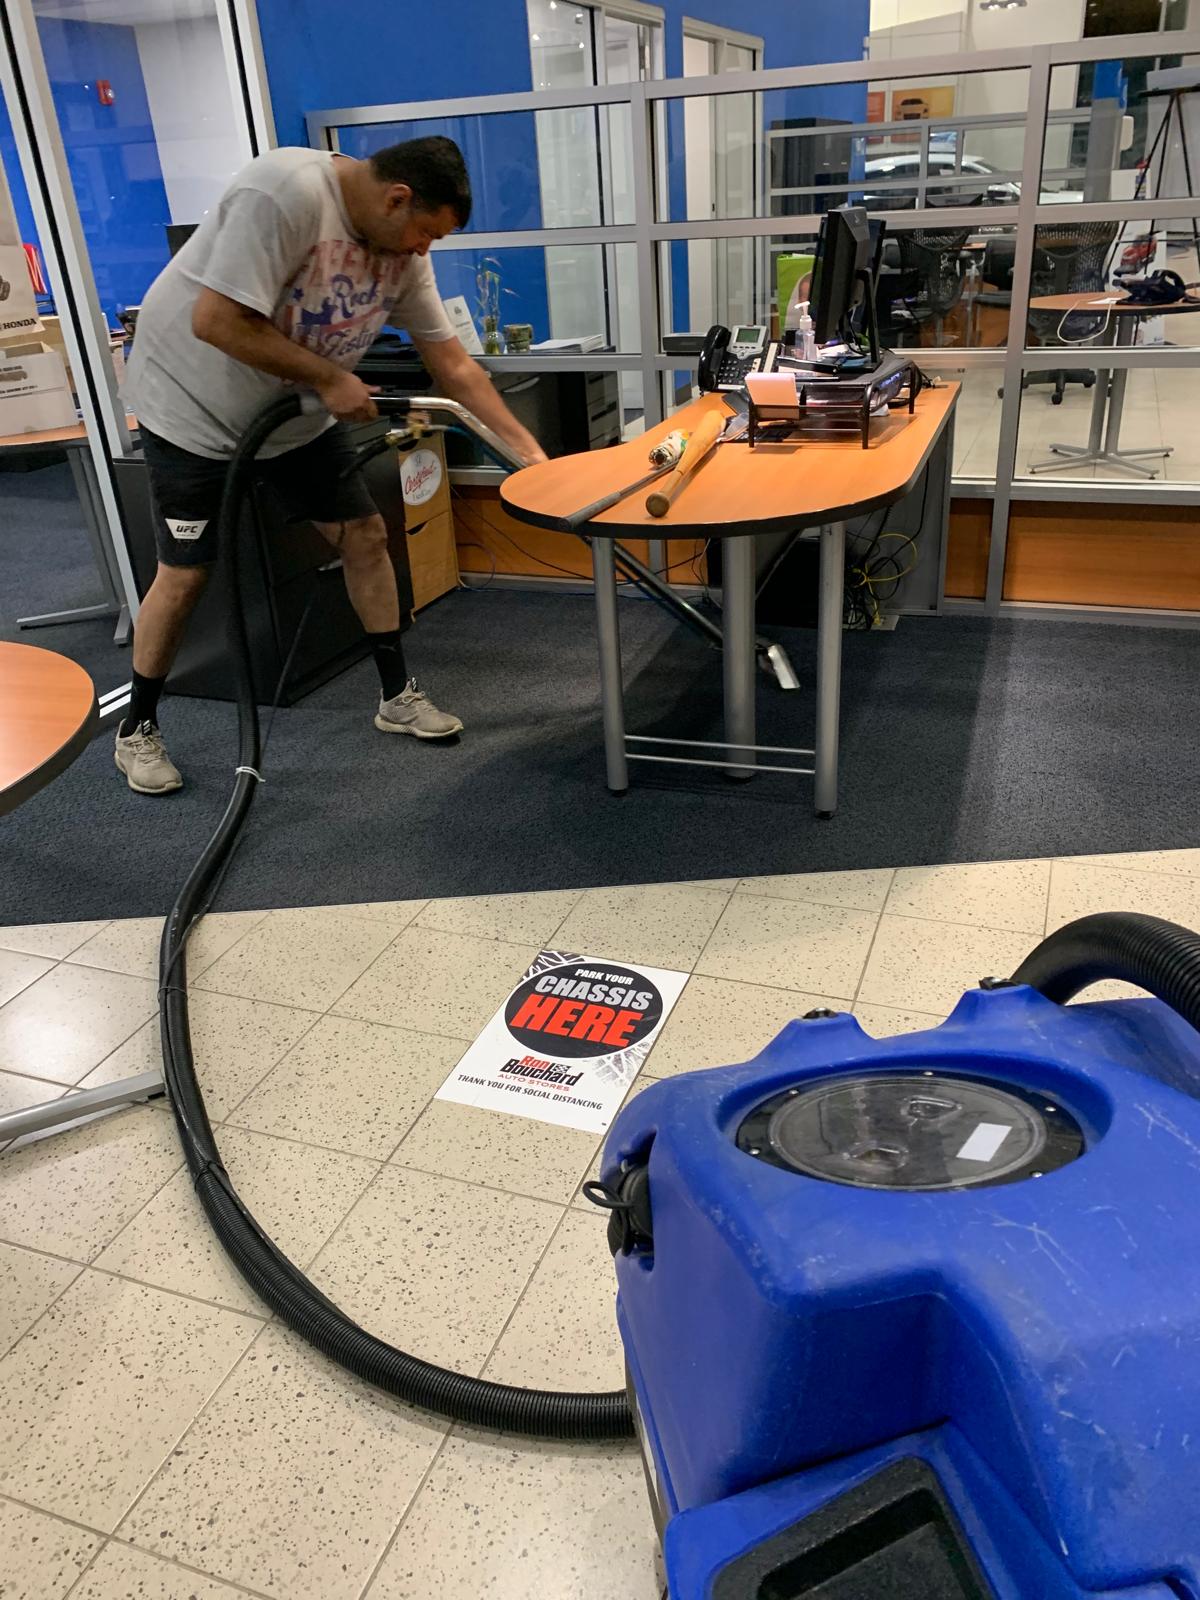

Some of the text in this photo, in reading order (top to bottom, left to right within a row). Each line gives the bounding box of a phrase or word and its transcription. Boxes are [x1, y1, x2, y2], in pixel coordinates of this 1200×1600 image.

[3, 318, 37, 330] HONDA
[176, 525, 198, 533] UFC
[574, 968, 634, 986] PARK YOUR
[534, 975, 653, 1010] CHASSIS
[509, 993, 644, 1047] HERE
[519, 1055, 550, 1069] Ron
[500, 1058, 584, 1087] Bouchard
[457, 1074, 603, 1110] THANK YOU FOR SOCIAL DISTANCING
[497, 1073, 570, 1092] AUTO STORES
